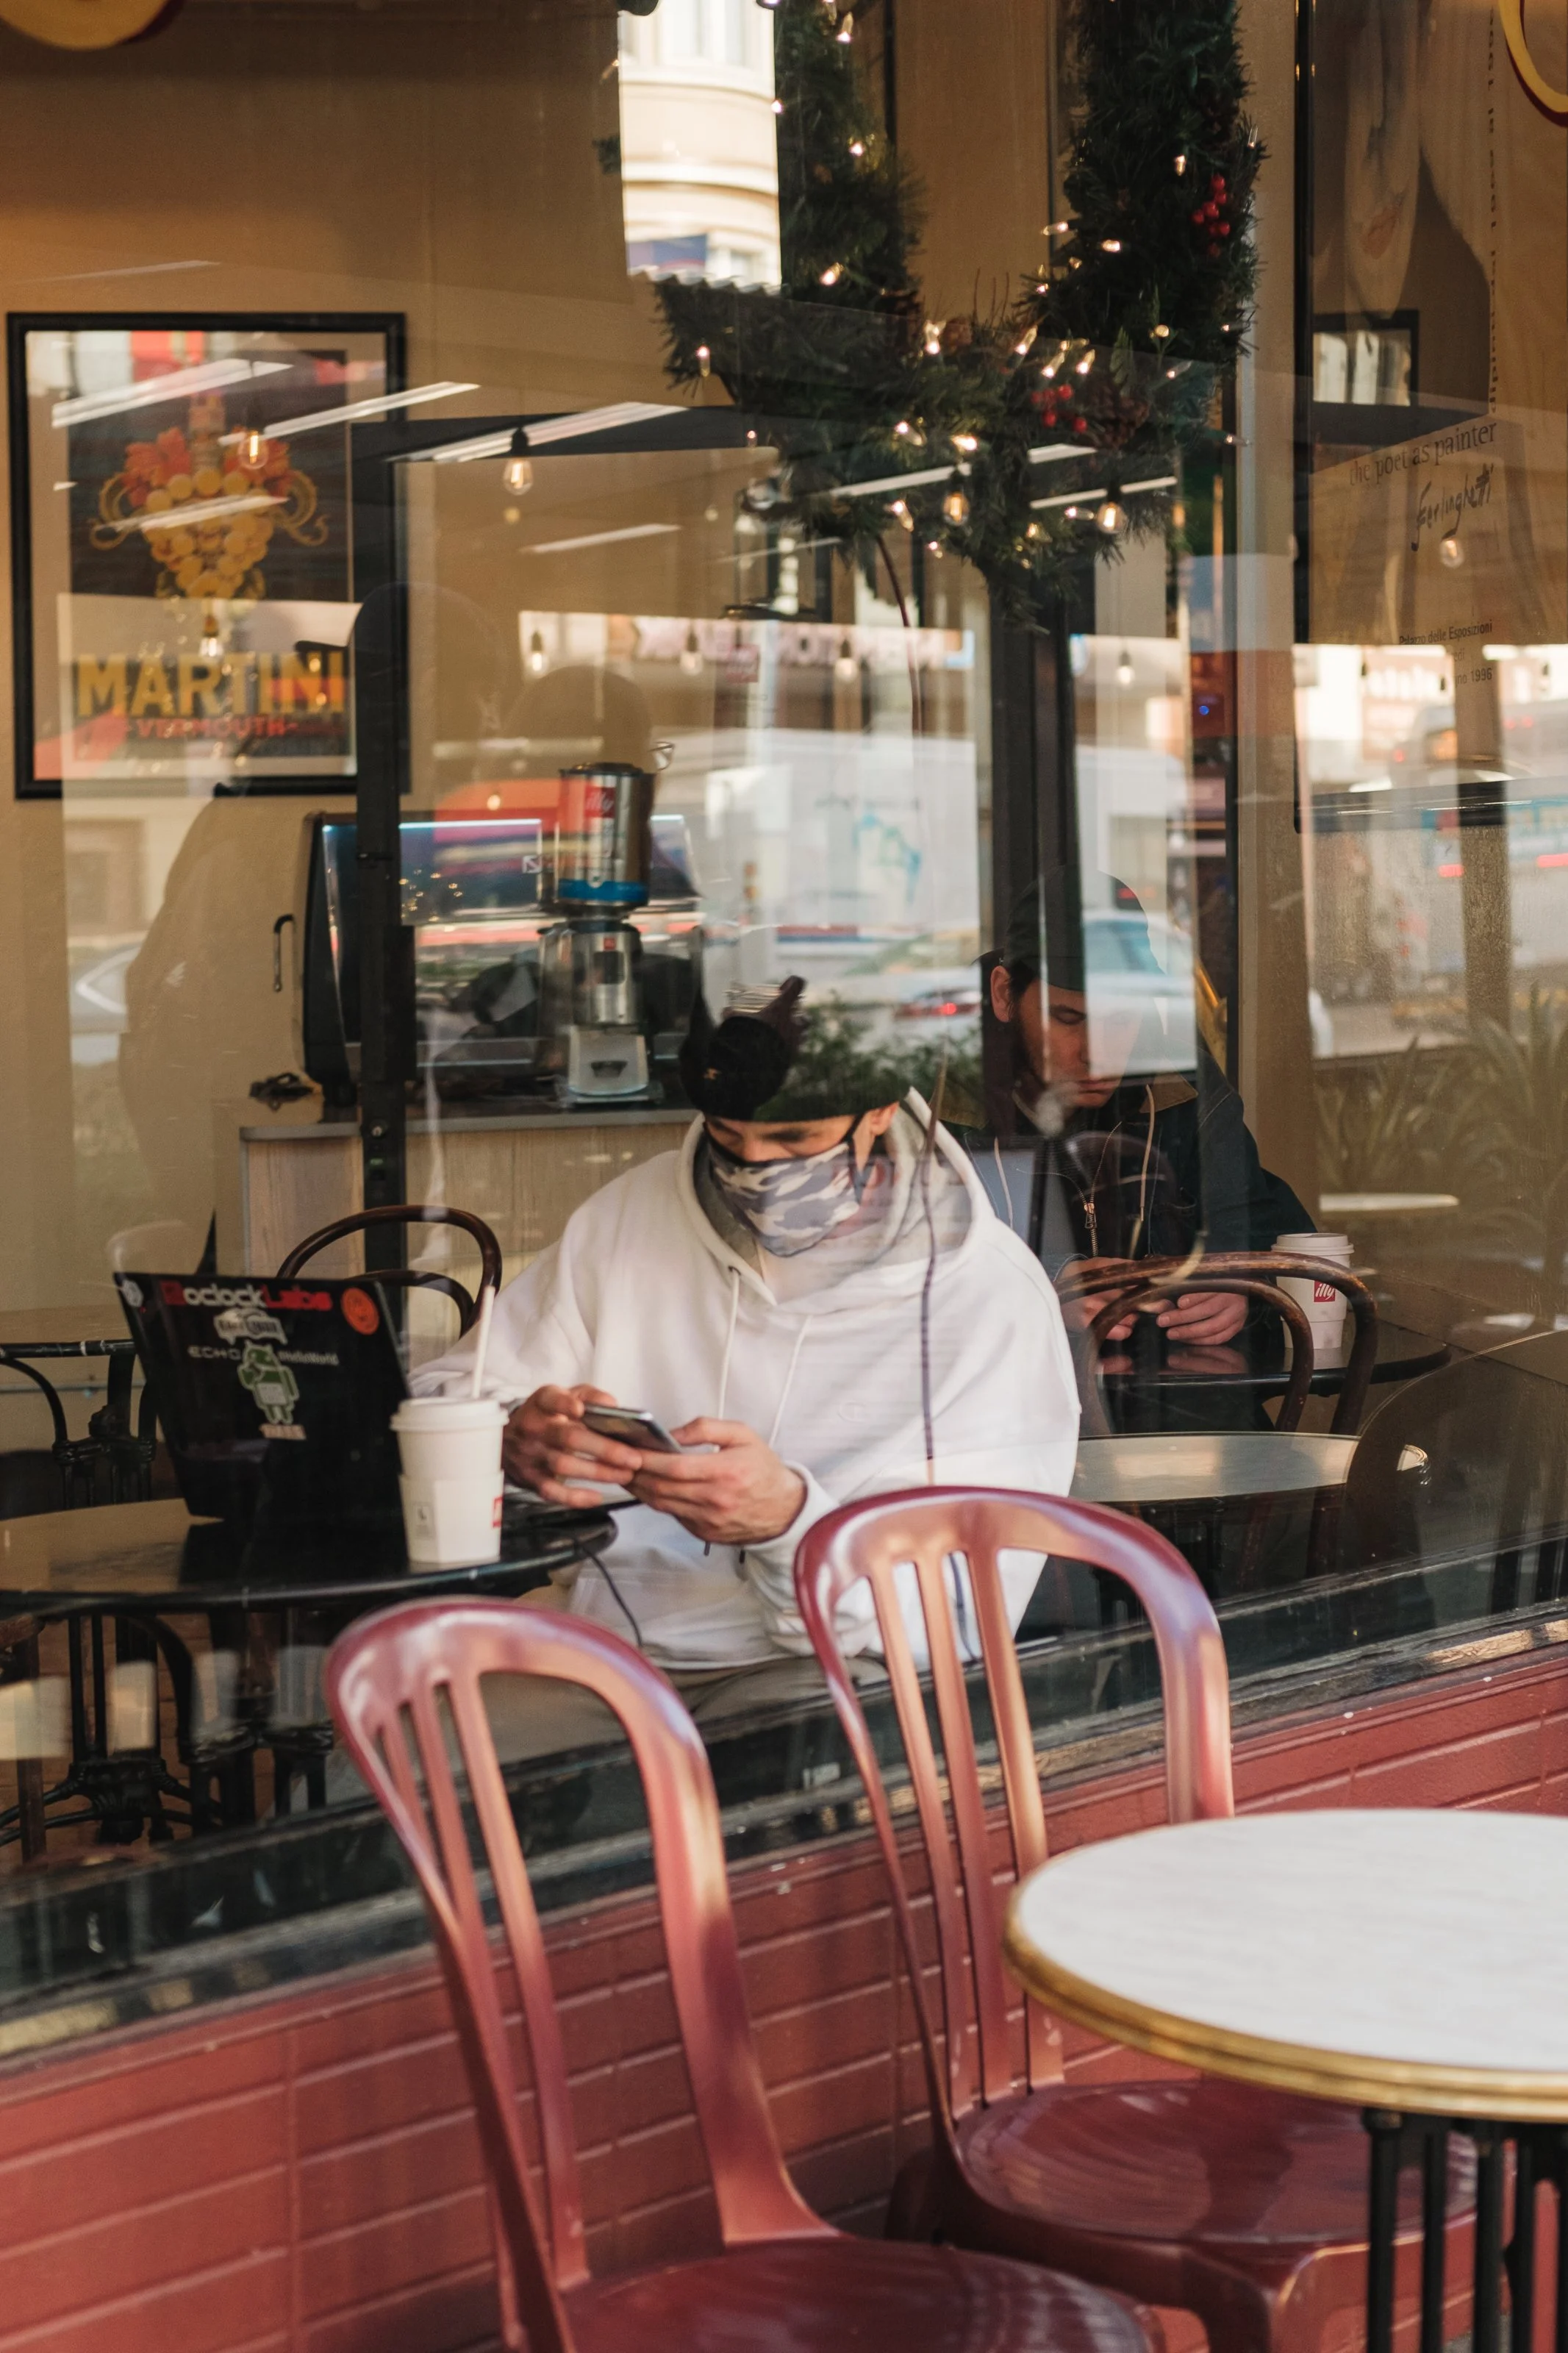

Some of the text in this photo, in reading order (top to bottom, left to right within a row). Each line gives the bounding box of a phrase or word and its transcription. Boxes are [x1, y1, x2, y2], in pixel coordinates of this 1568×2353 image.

[1350, 422, 1497, 486] the poet as painter
[1428, 628, 1447, 643] delle
[1448, 619, 1493, 643] Esposizioni
[76, 651, 346, 716] MARTINI
[1470, 667, 1493, 682] 1996
[1315, 1283, 1335, 1301] illy
